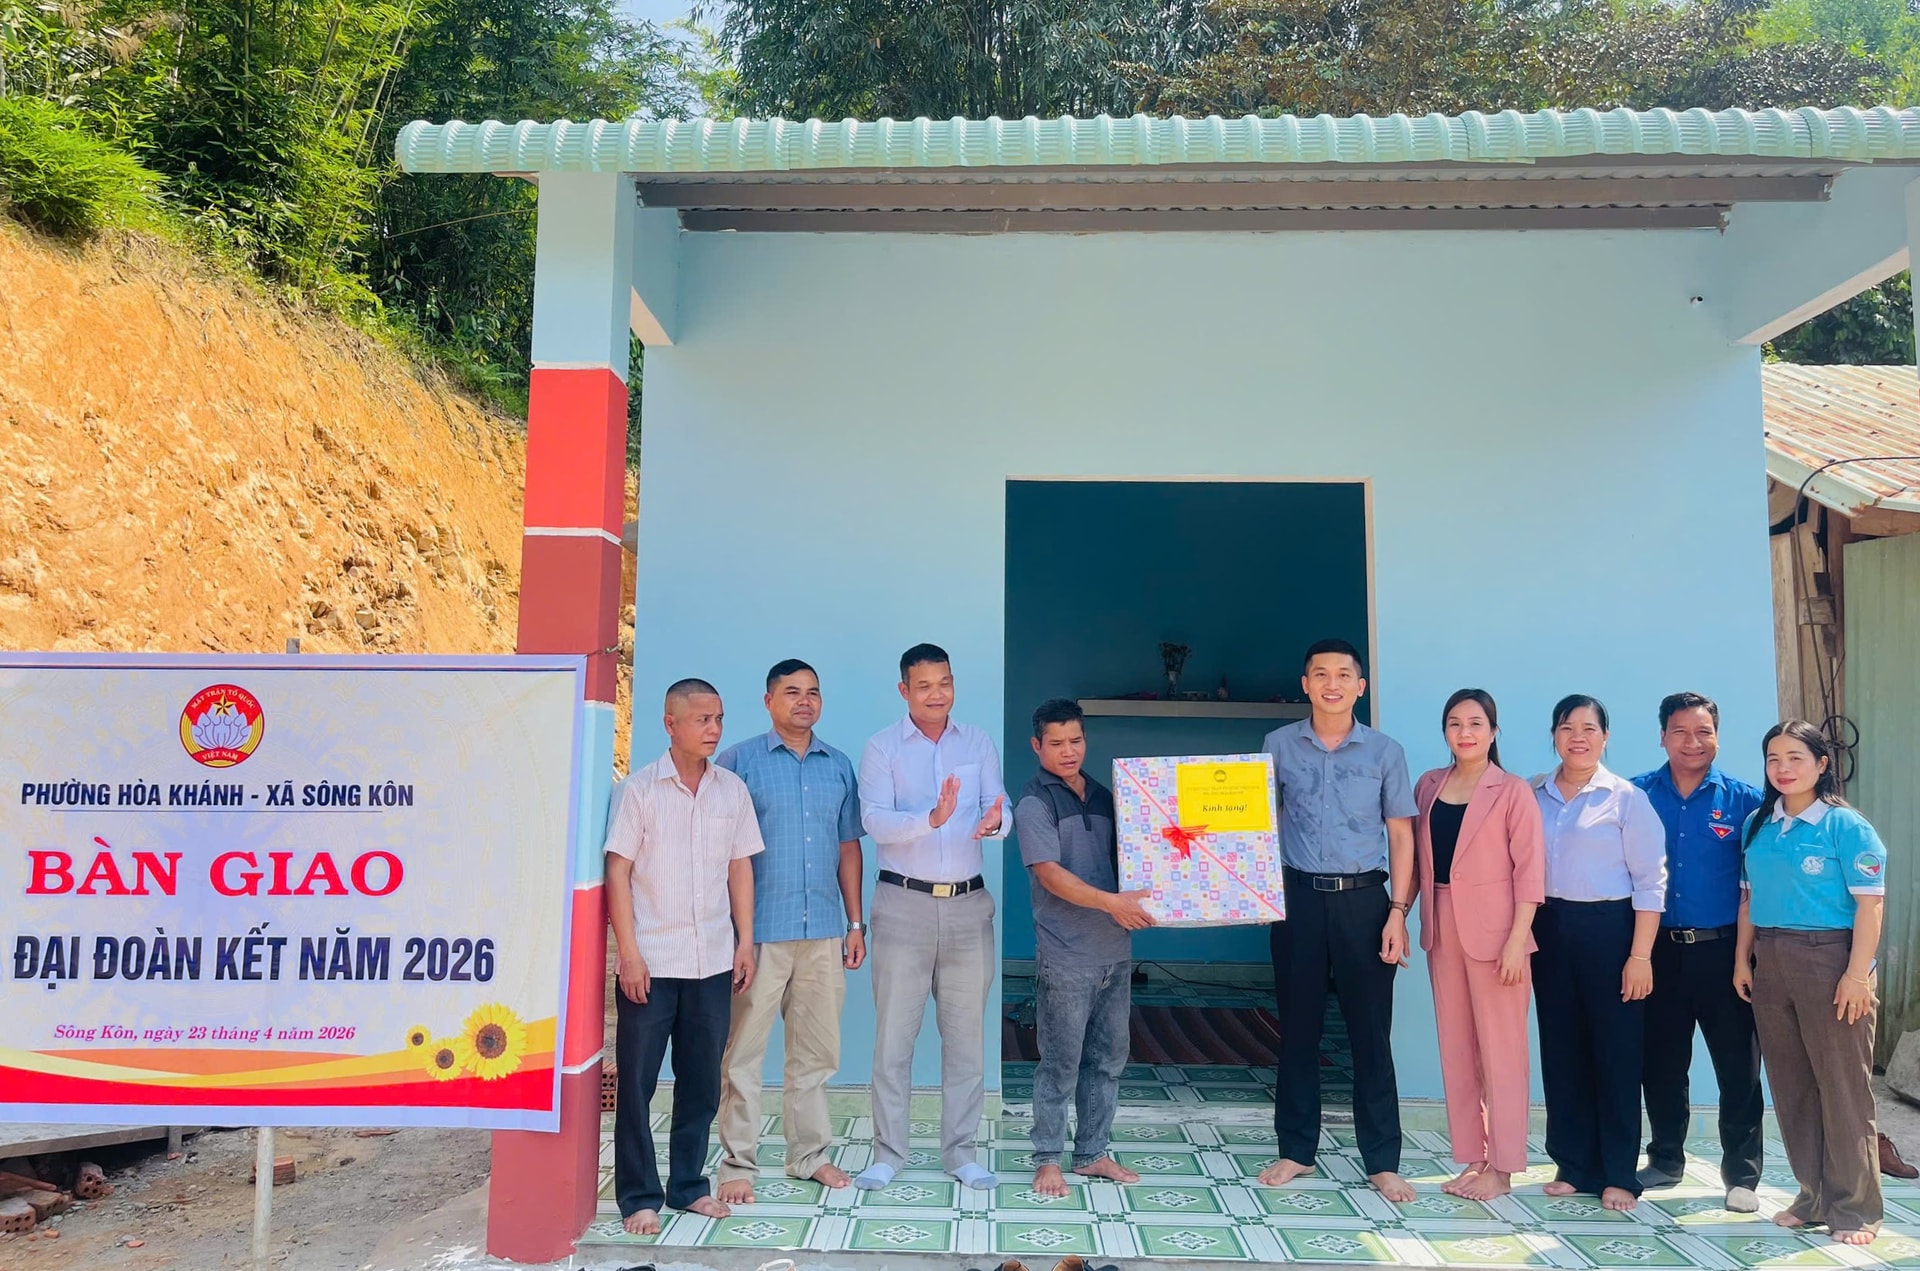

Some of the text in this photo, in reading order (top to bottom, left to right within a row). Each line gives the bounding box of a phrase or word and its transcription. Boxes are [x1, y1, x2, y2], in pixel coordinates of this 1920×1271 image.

[221, 751, 239, 760] NAM
[21, 778, 111, 806] PHƯỜNG
[118, 778, 161, 806] HÒA
[168, 779, 244, 806] KHÁNH
[265, 780, 295, 806] XÃ
[302, 780, 361, 806] SÔNG
[368, 780, 414, 806] KÔN
[25, 836, 404, 896] BÀN GIAO
[14, 922, 495, 990] ĐẠI ĐOÀN KẾT NĂM 2026
[54, 1024, 356, 1042] Sông Kôn, ngày 23 tháng 4 năm 2026
